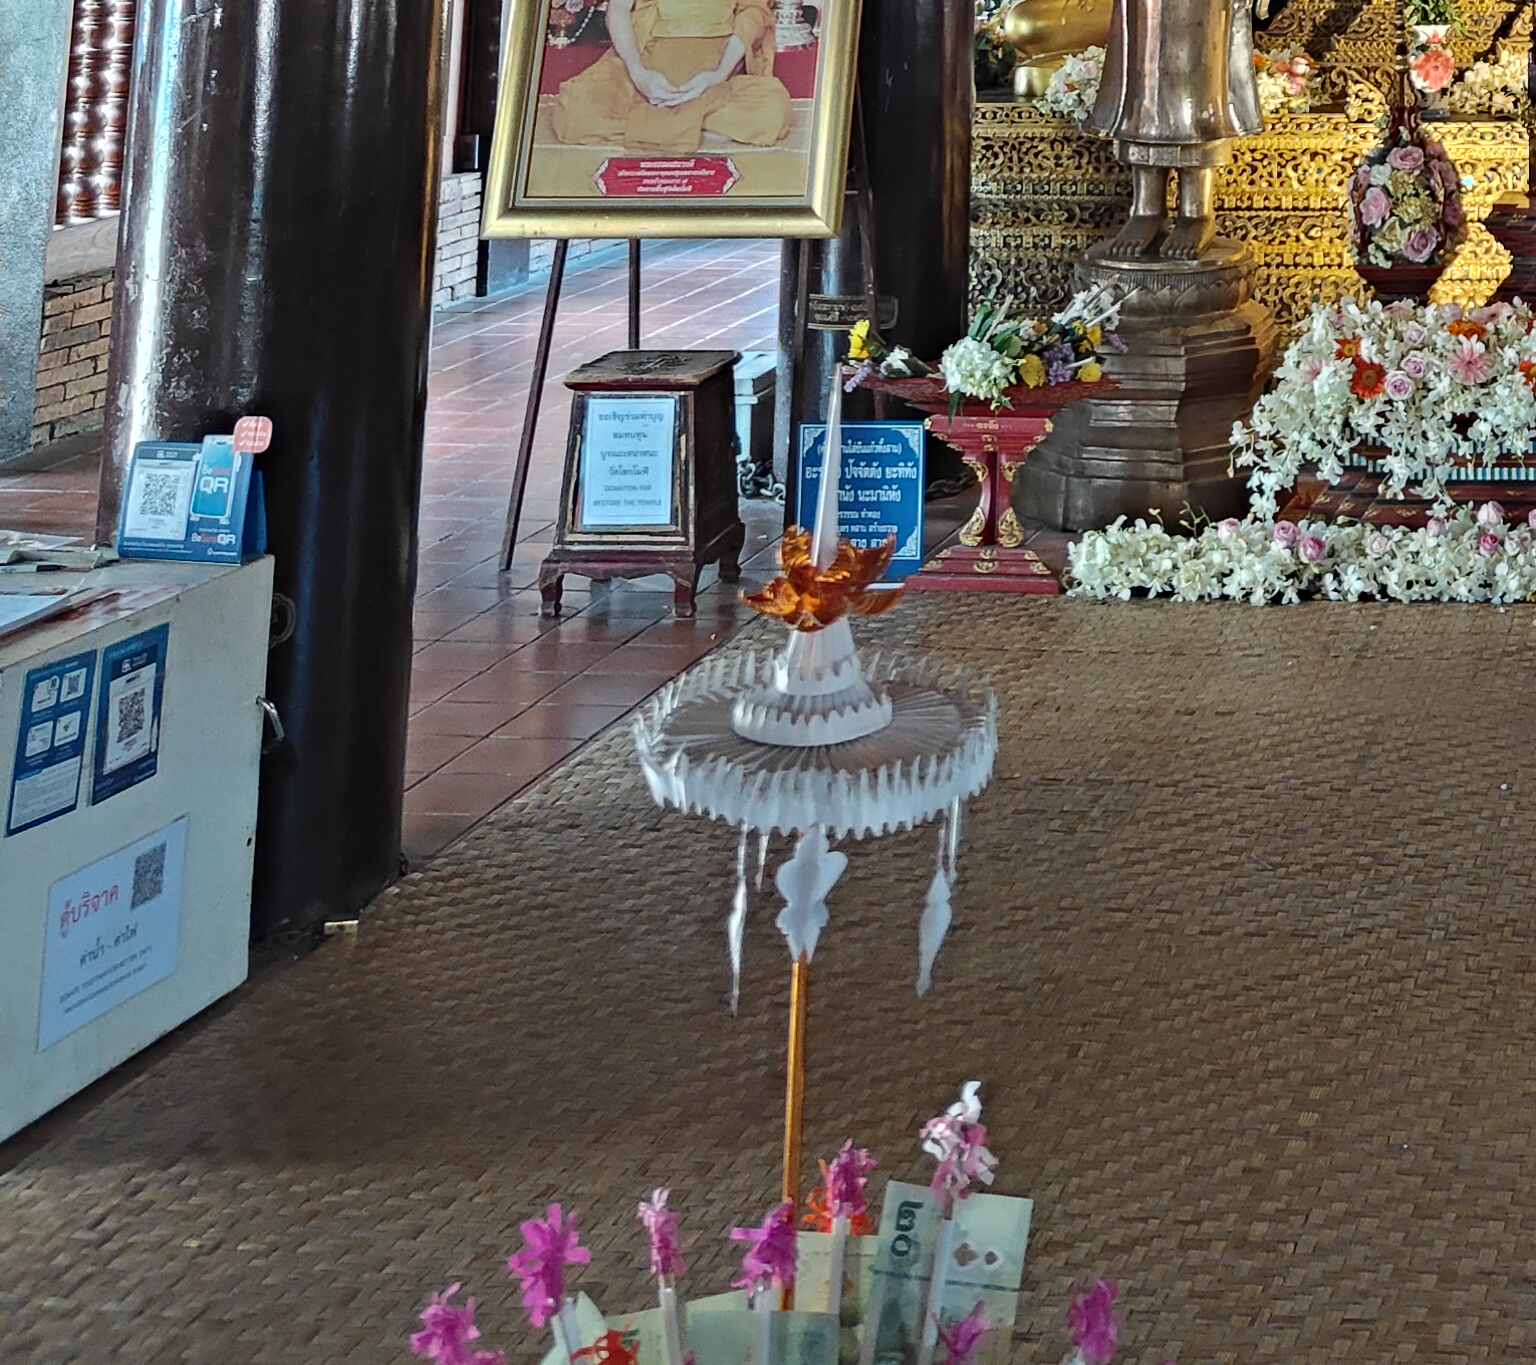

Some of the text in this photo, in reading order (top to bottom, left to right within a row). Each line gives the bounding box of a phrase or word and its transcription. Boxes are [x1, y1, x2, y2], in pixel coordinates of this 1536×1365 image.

[200, 476, 229, 495] QR
[59, 883, 120, 939] ตู้บริจาค
